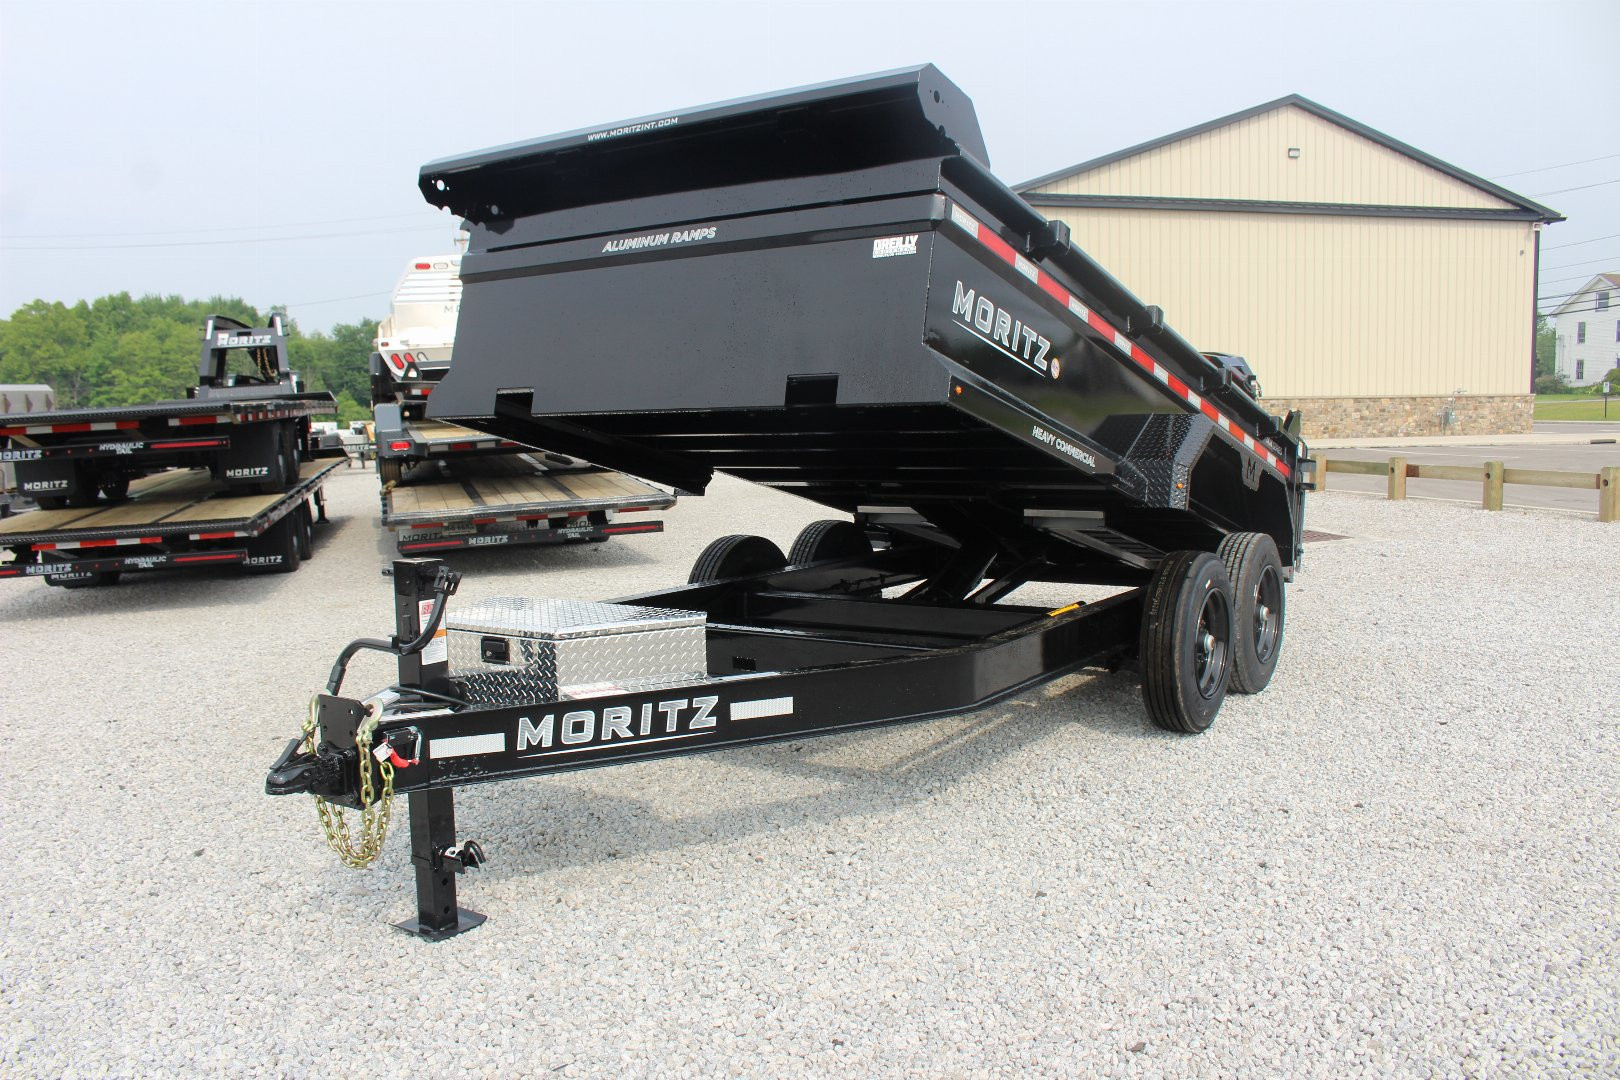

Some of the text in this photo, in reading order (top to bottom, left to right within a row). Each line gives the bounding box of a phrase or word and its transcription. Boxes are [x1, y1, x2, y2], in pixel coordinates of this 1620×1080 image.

[587, 117, 678, 141] WWW.MORITZINT.COM
[602, 227, 717, 253] ALUMINUM RAMPS
[952, 280, 1050, 371] MORITZ
[99, 442, 144, 450] HYDRAULIC
[1032, 425, 1095, 467] HEAVY COMMERCIAL
[226, 467, 268, 478] MORITZ
[24, 480, 68, 491] MORITZ
[468, 535, 509, 545] MORITZ
[124, 555, 167, 565] HYDRAULIC
[26, 563, 72, 574] MORITZ
[516, 695, 719, 751] MORITZ
